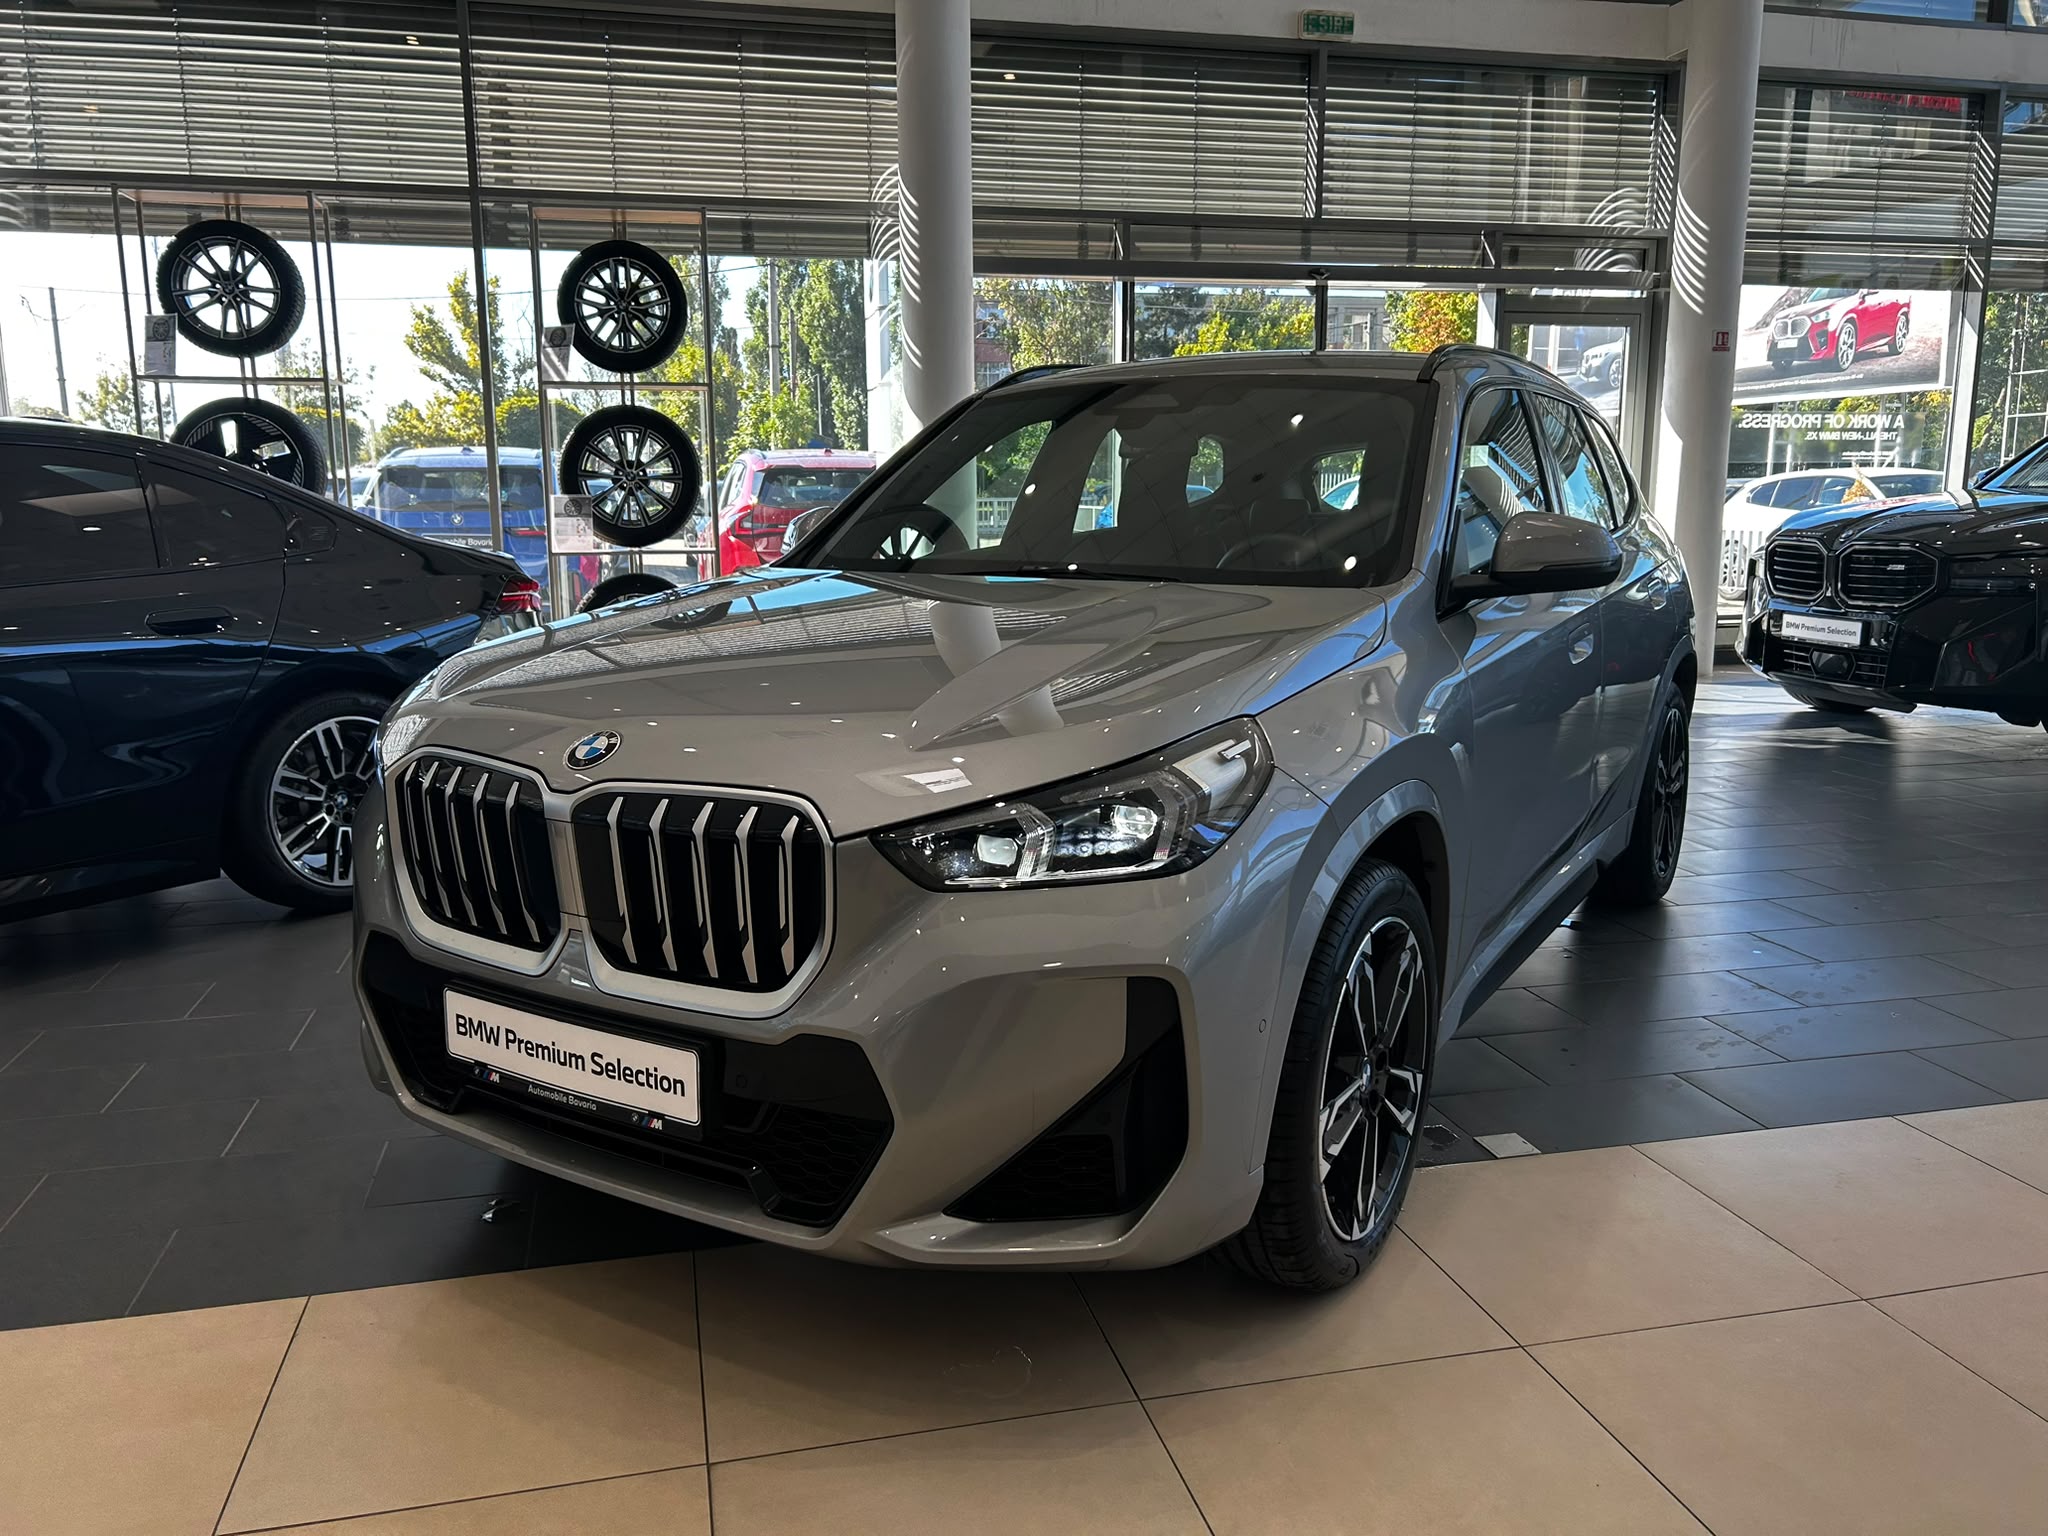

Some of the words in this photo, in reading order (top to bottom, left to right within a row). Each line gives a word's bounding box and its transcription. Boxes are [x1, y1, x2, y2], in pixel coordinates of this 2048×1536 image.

[1785, 621, 1801, 630] BMW
[1801, 623, 1826, 633] Premium
[1827, 626, 1857, 637] Selection
[455, 1013, 501, 1047] BMW
[504, 1028, 586, 1072] Premium
[590, 1052, 686, 1097] Selection
[528, 1084, 567, 1104] Automobile
[568, 1095, 597, 1111] Bavaria
